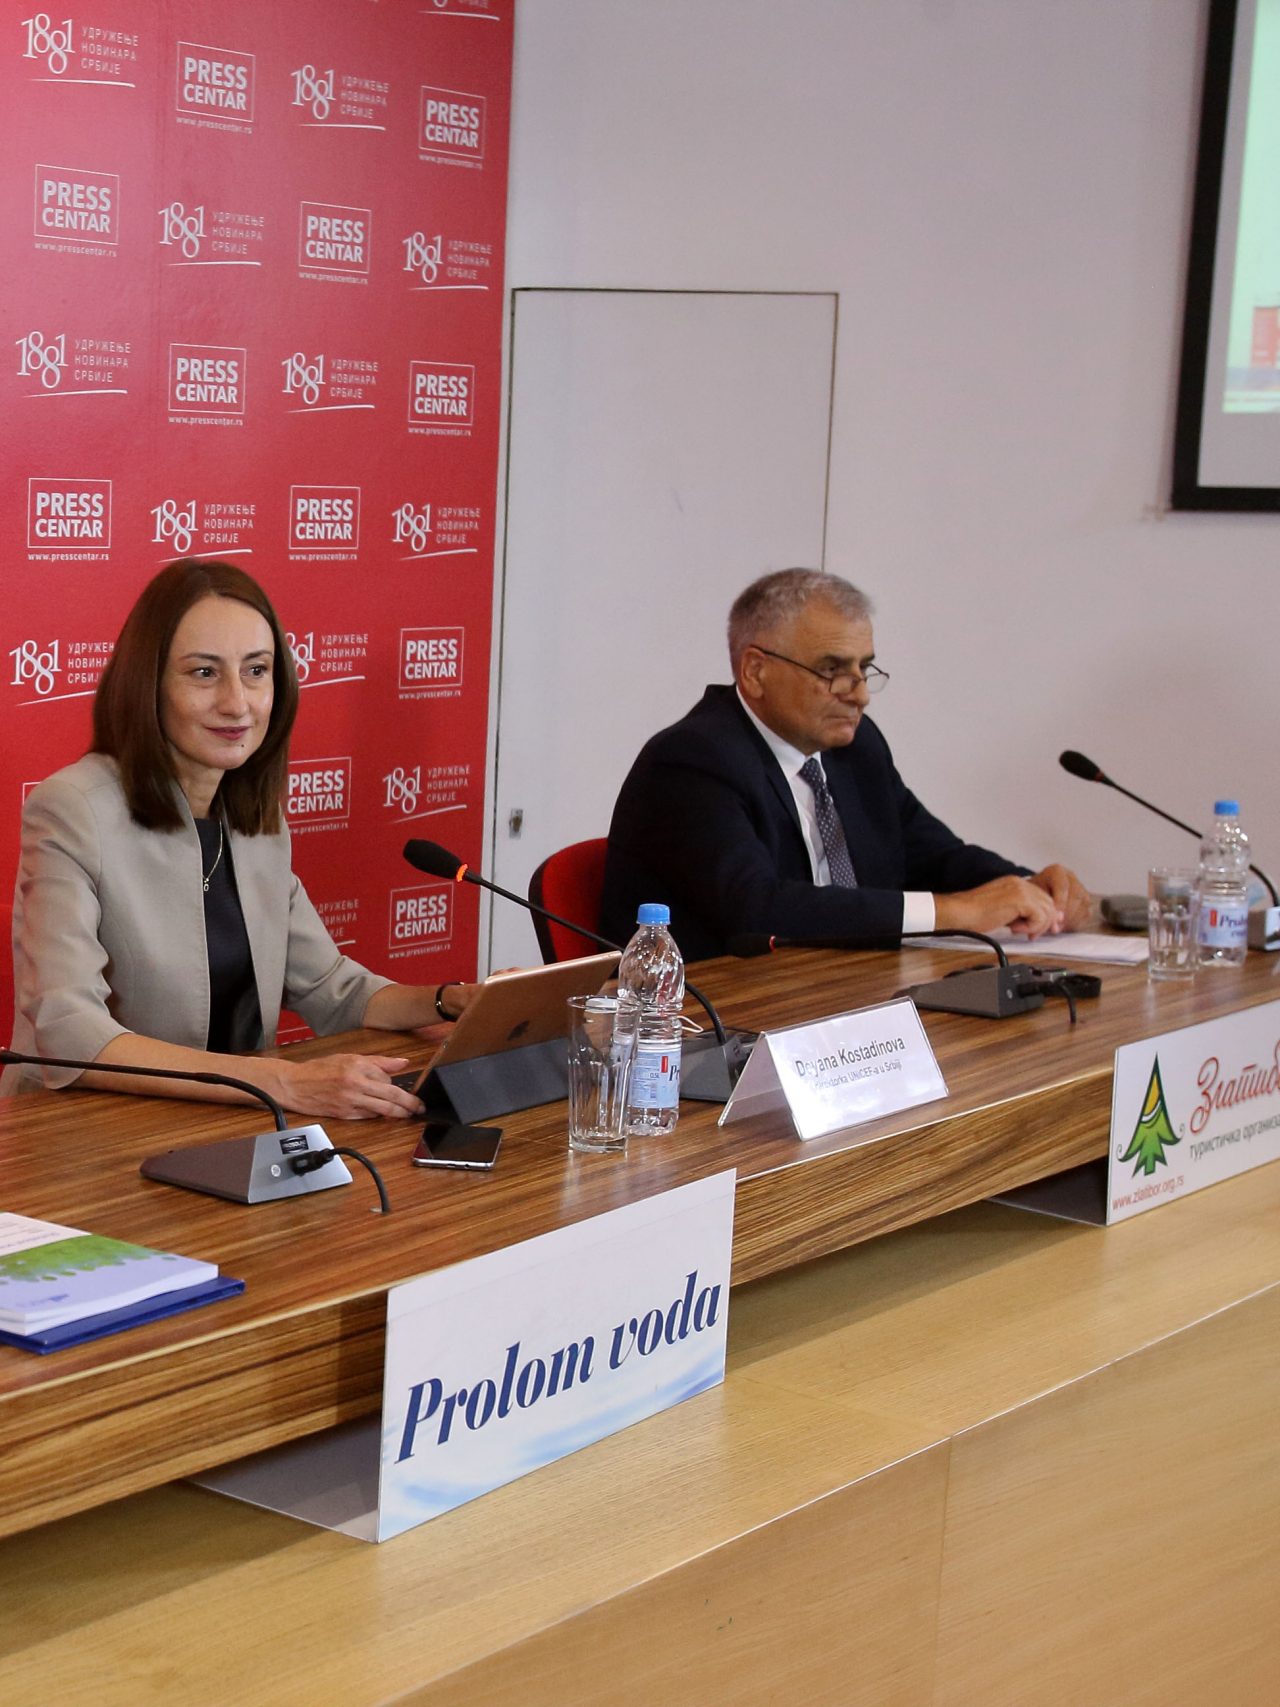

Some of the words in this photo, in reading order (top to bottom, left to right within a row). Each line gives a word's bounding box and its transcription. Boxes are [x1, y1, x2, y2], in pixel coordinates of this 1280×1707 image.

[21, 14, 75, 74] 1881
[185, 57, 247, 90] PRESS
[184, 84, 246, 110] CENTAR
[291, 65, 336, 120] 1881
[427, 100, 479, 129] PRESS
[426, 124, 478, 148] CENTAR
[43, 180, 111, 212] PRESS
[42, 208, 110, 233] CENTAR
[158, 202, 207, 258] 1881
[307, 216, 364, 243] PRESS
[306, 240, 363, 263] CENTAR
[403, 232, 443, 283] 1881
[16, 332, 68, 389] 1881
[177, 358, 238, 384] PRESS
[282, 353, 326, 405] 1881
[416, 374, 468, 398] PRESS
[176, 383, 238, 403] CENTAR
[415, 397, 467, 416] CENTAR
[37, 493, 103, 517] PRESS
[297, 499, 353, 521] PRESS
[35, 519, 103, 538] CENTAR
[151, 500, 200, 554] 1881
[296, 523, 352, 540] CENTAR
[392, 503, 432, 552] 1881
[406, 639, 458, 661] PRESS
[9, 640, 62, 695] 1881
[405, 661, 457, 679] CENTAR
[289, 770, 344, 796] PRESS
[383, 766, 422, 814] 1881
[287, 793, 343, 814] CENTAR
[396, 895, 447, 921] PRESS
[395, 917, 446, 939] CENTAR
[838, 1037, 906, 1066] Kostadinova
[394, 1342, 595, 1464] Prolom
[609, 1270, 722, 1371] voda
